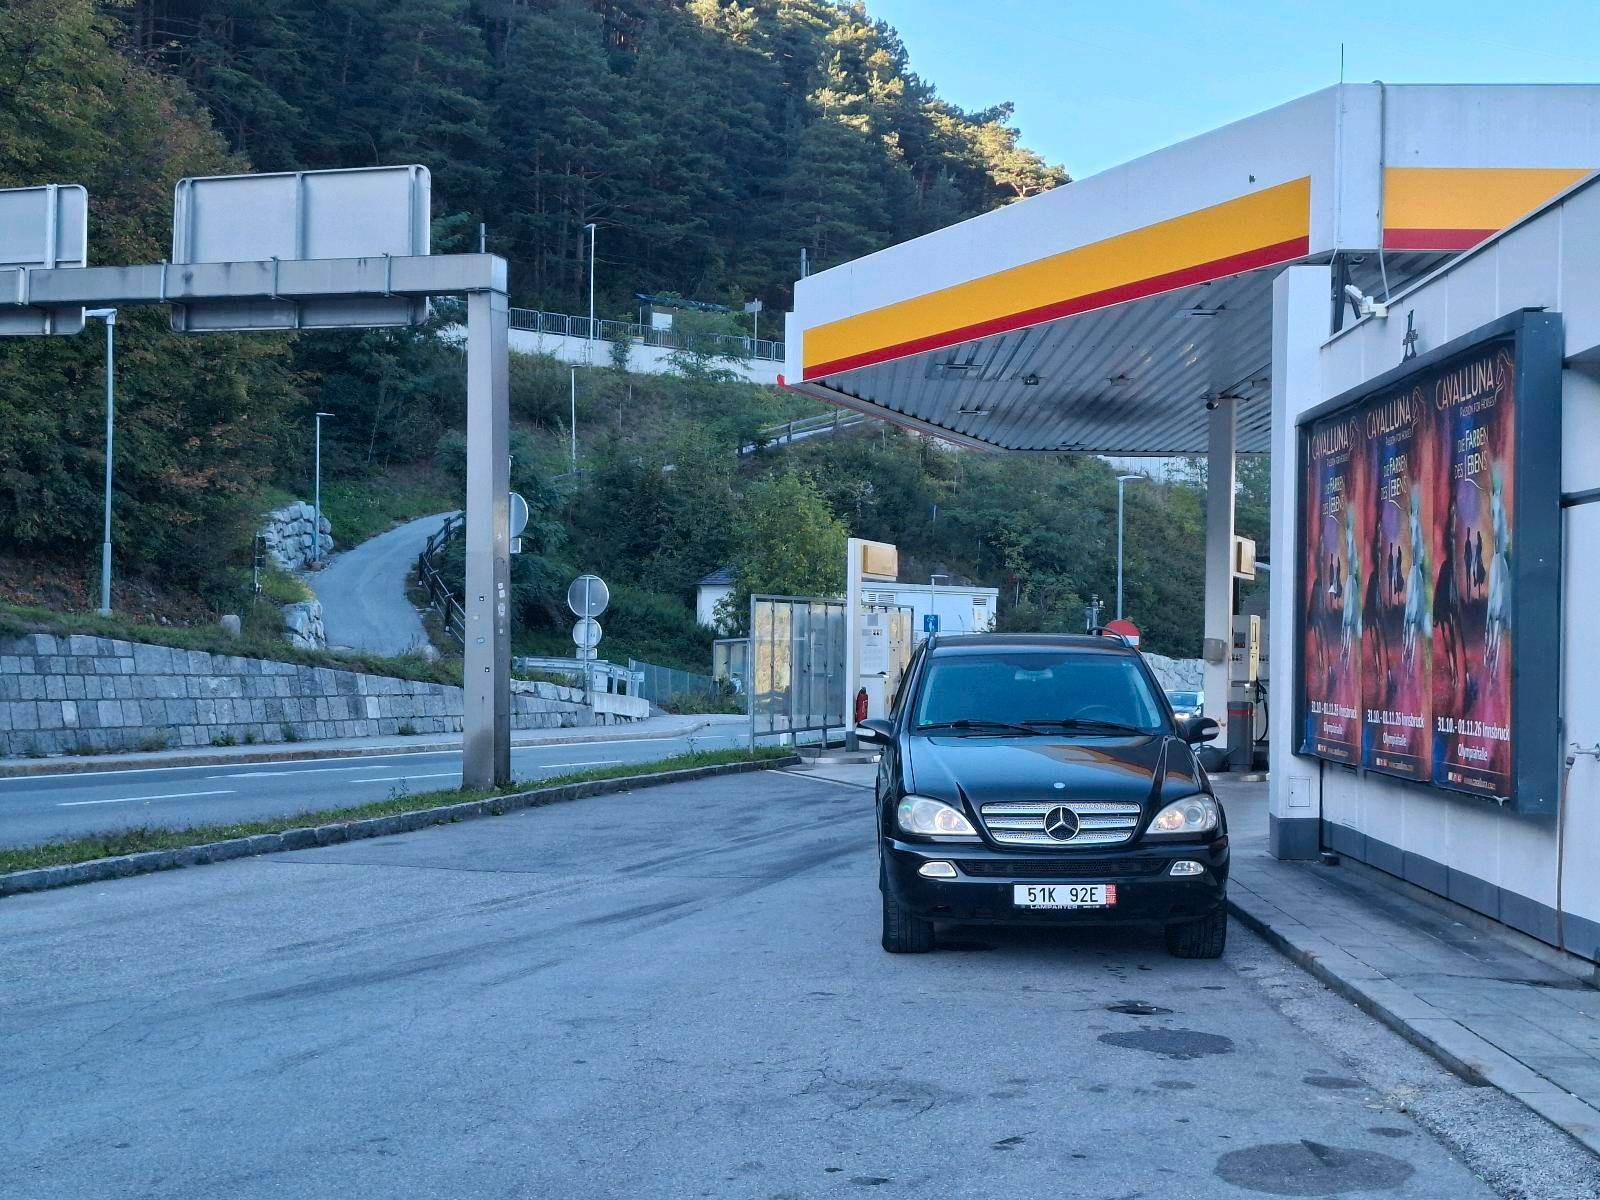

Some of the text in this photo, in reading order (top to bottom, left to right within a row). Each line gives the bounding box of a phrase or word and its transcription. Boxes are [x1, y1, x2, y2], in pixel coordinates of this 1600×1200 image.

[1435, 358, 1494, 411] CAVALLUNA
[1366, 395, 1412, 440] CAVALLUNA
[1312, 422, 1349, 460] CAVALLUNA
[1465, 425, 1489, 451] FARBEN
[1402, 712, 1425, 729] Innsbruck
[1458, 719, 1482, 736] 01.11.26
[1483, 722, 1510, 741] Innsbruck
[1028, 888, 1056, 903] 51K
[1070, 887, 1099, 903] 92E
